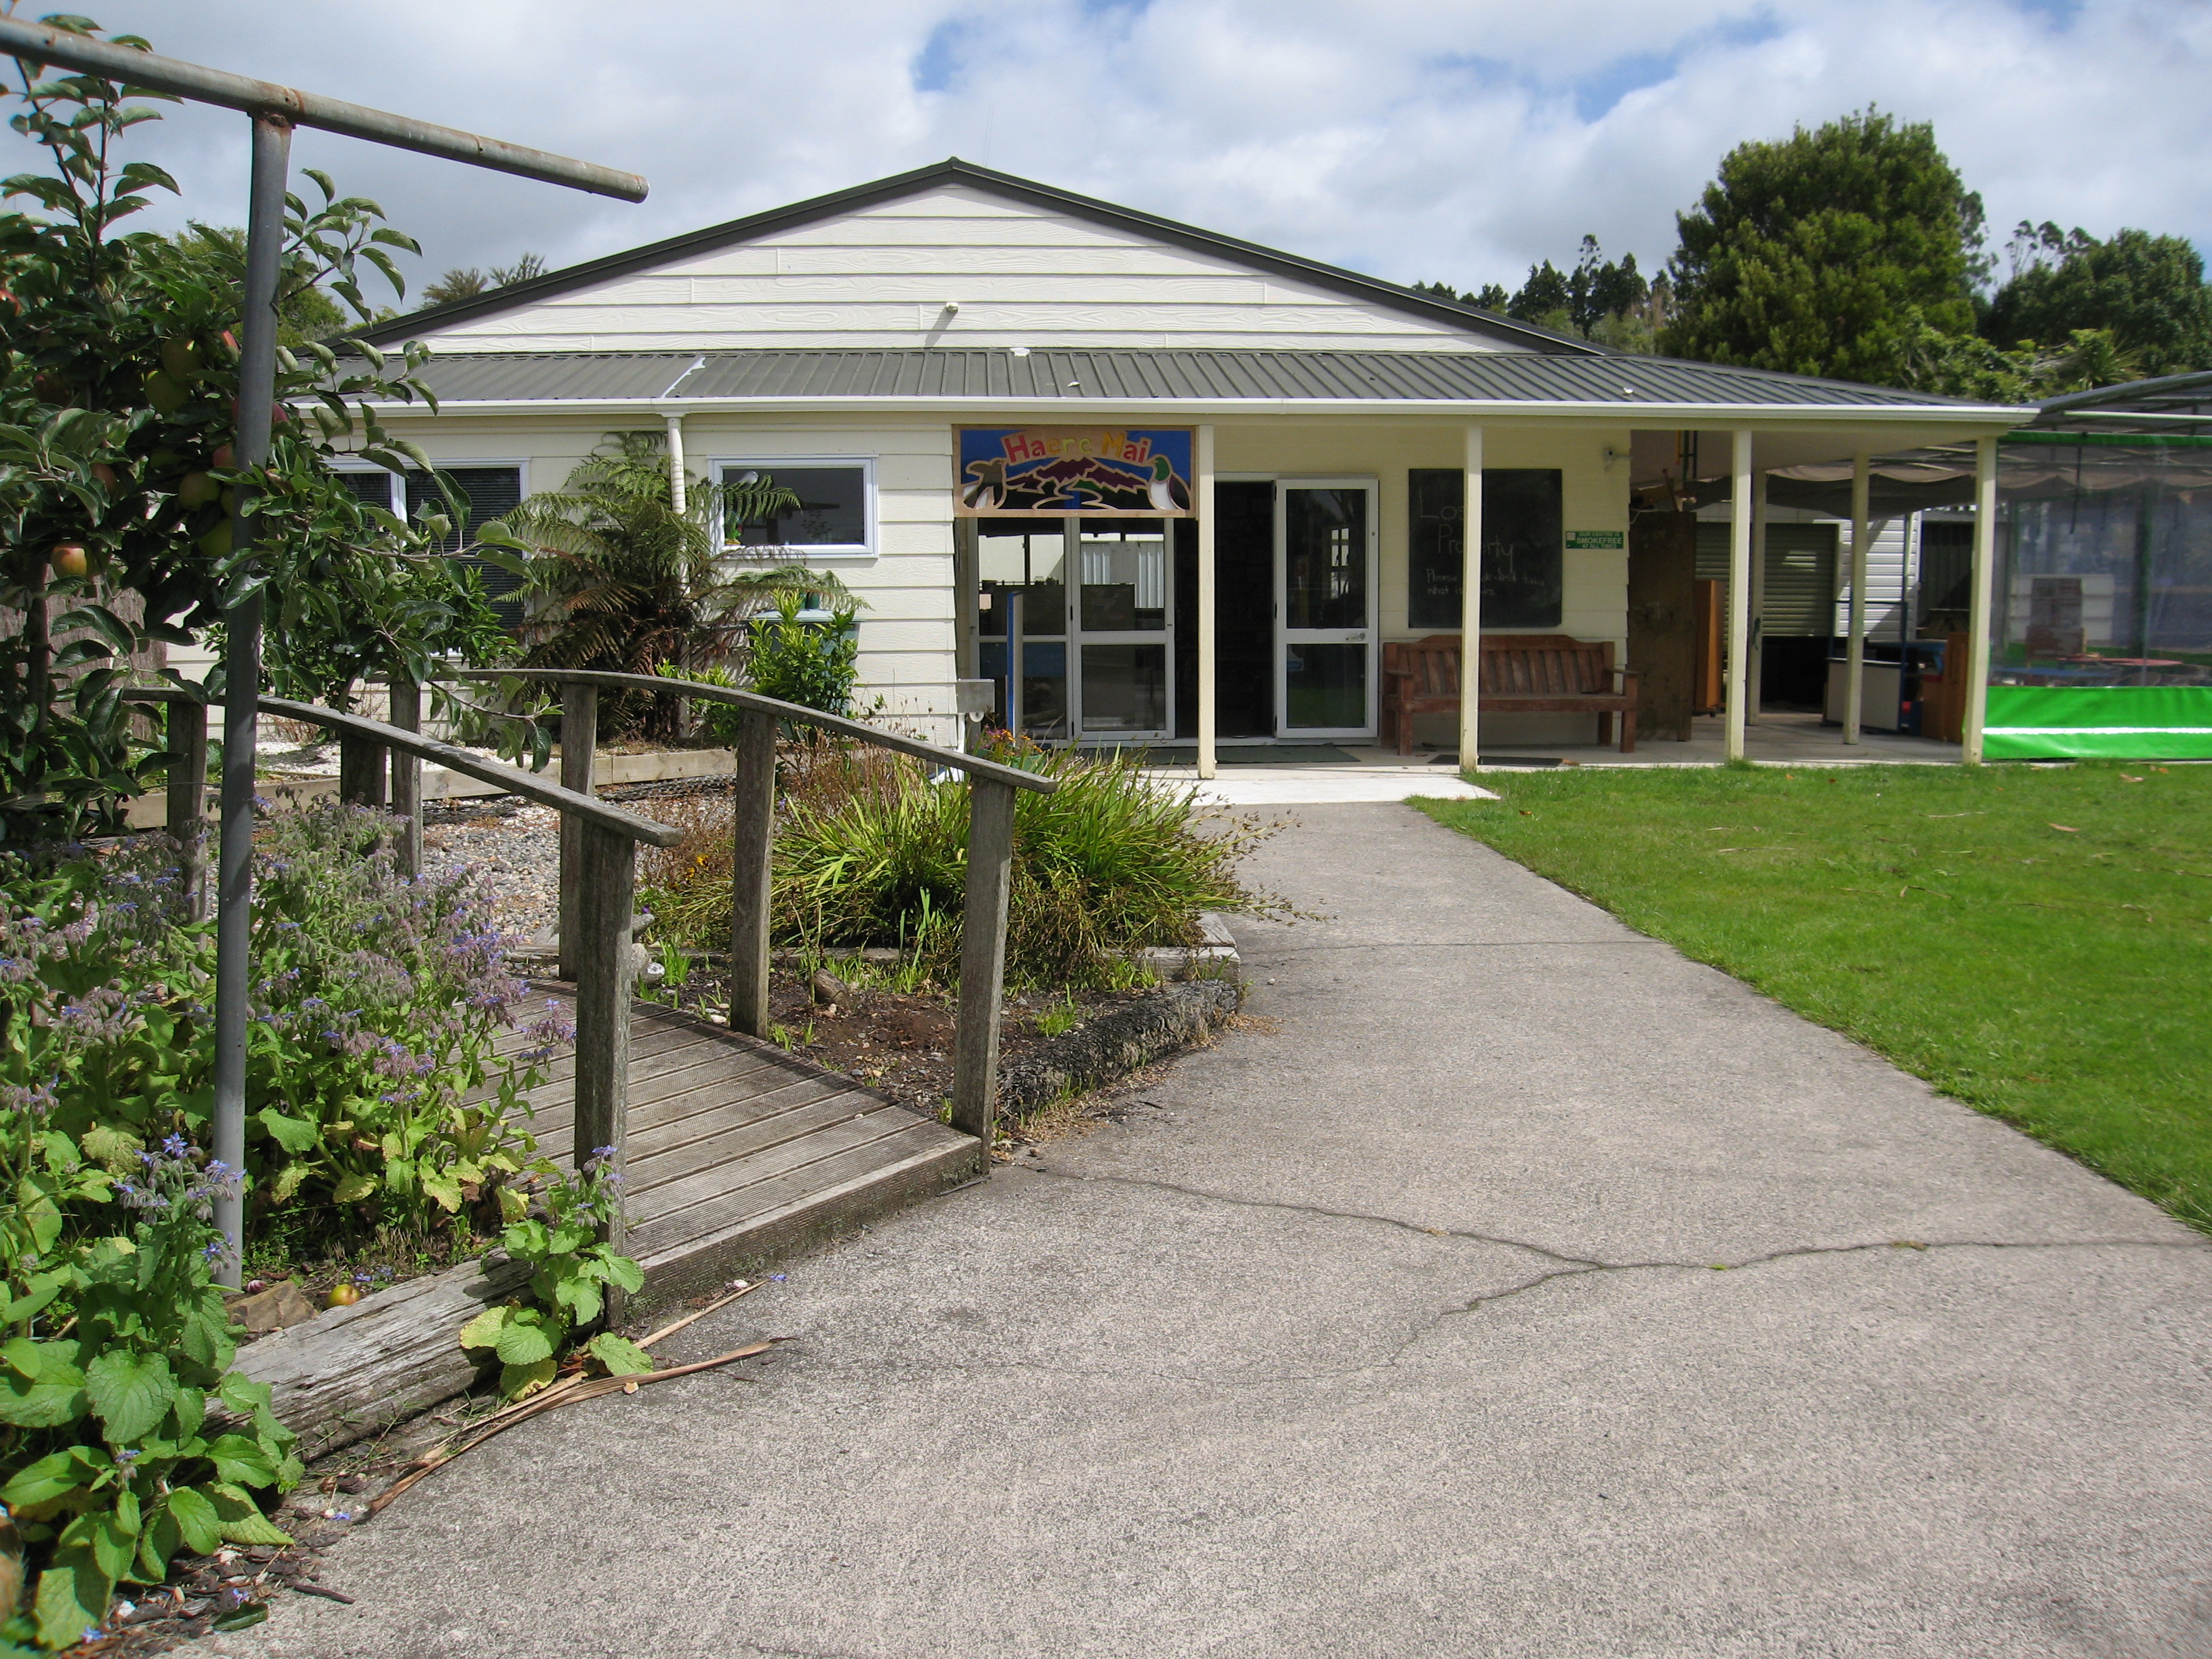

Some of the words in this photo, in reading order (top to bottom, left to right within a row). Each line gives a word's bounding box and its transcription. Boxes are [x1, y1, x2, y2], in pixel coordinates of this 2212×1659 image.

[1005, 436, 1092, 463] Haere
[1101, 432, 1148, 464] Mai
[1426, 569, 1458, 583] Please
